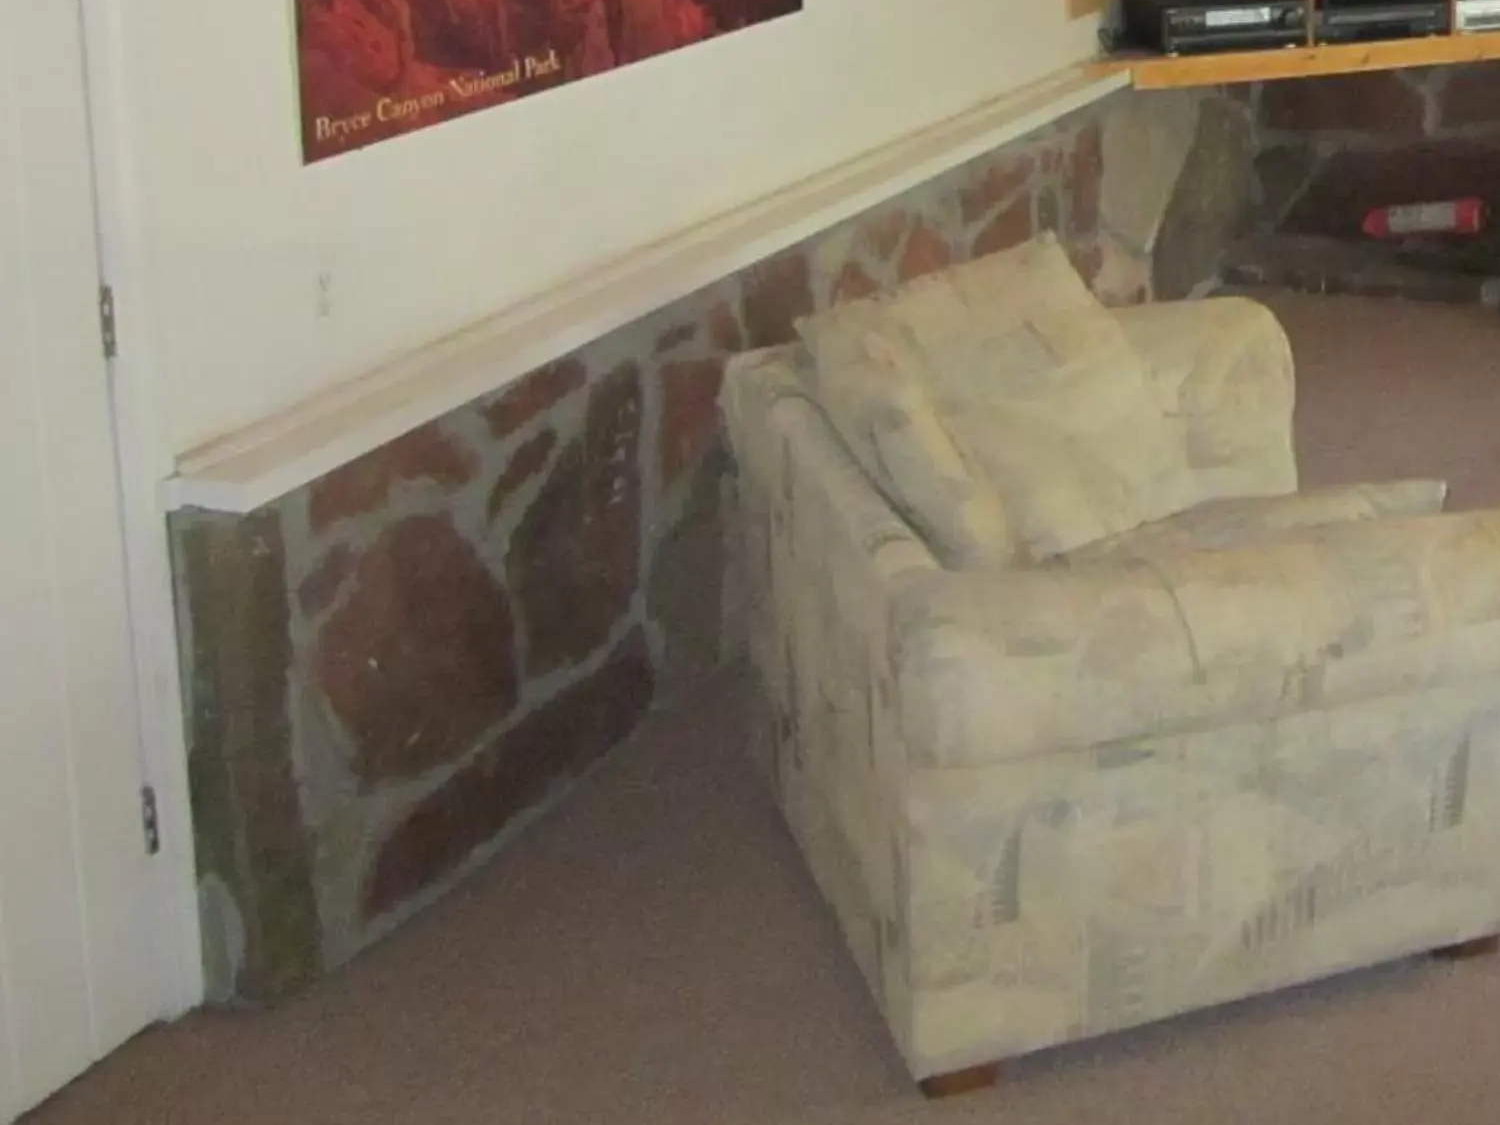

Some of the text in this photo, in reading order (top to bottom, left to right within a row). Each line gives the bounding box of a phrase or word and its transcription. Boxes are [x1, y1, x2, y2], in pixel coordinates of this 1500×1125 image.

[316, 49, 560, 142] Bryce Canyon National Park
